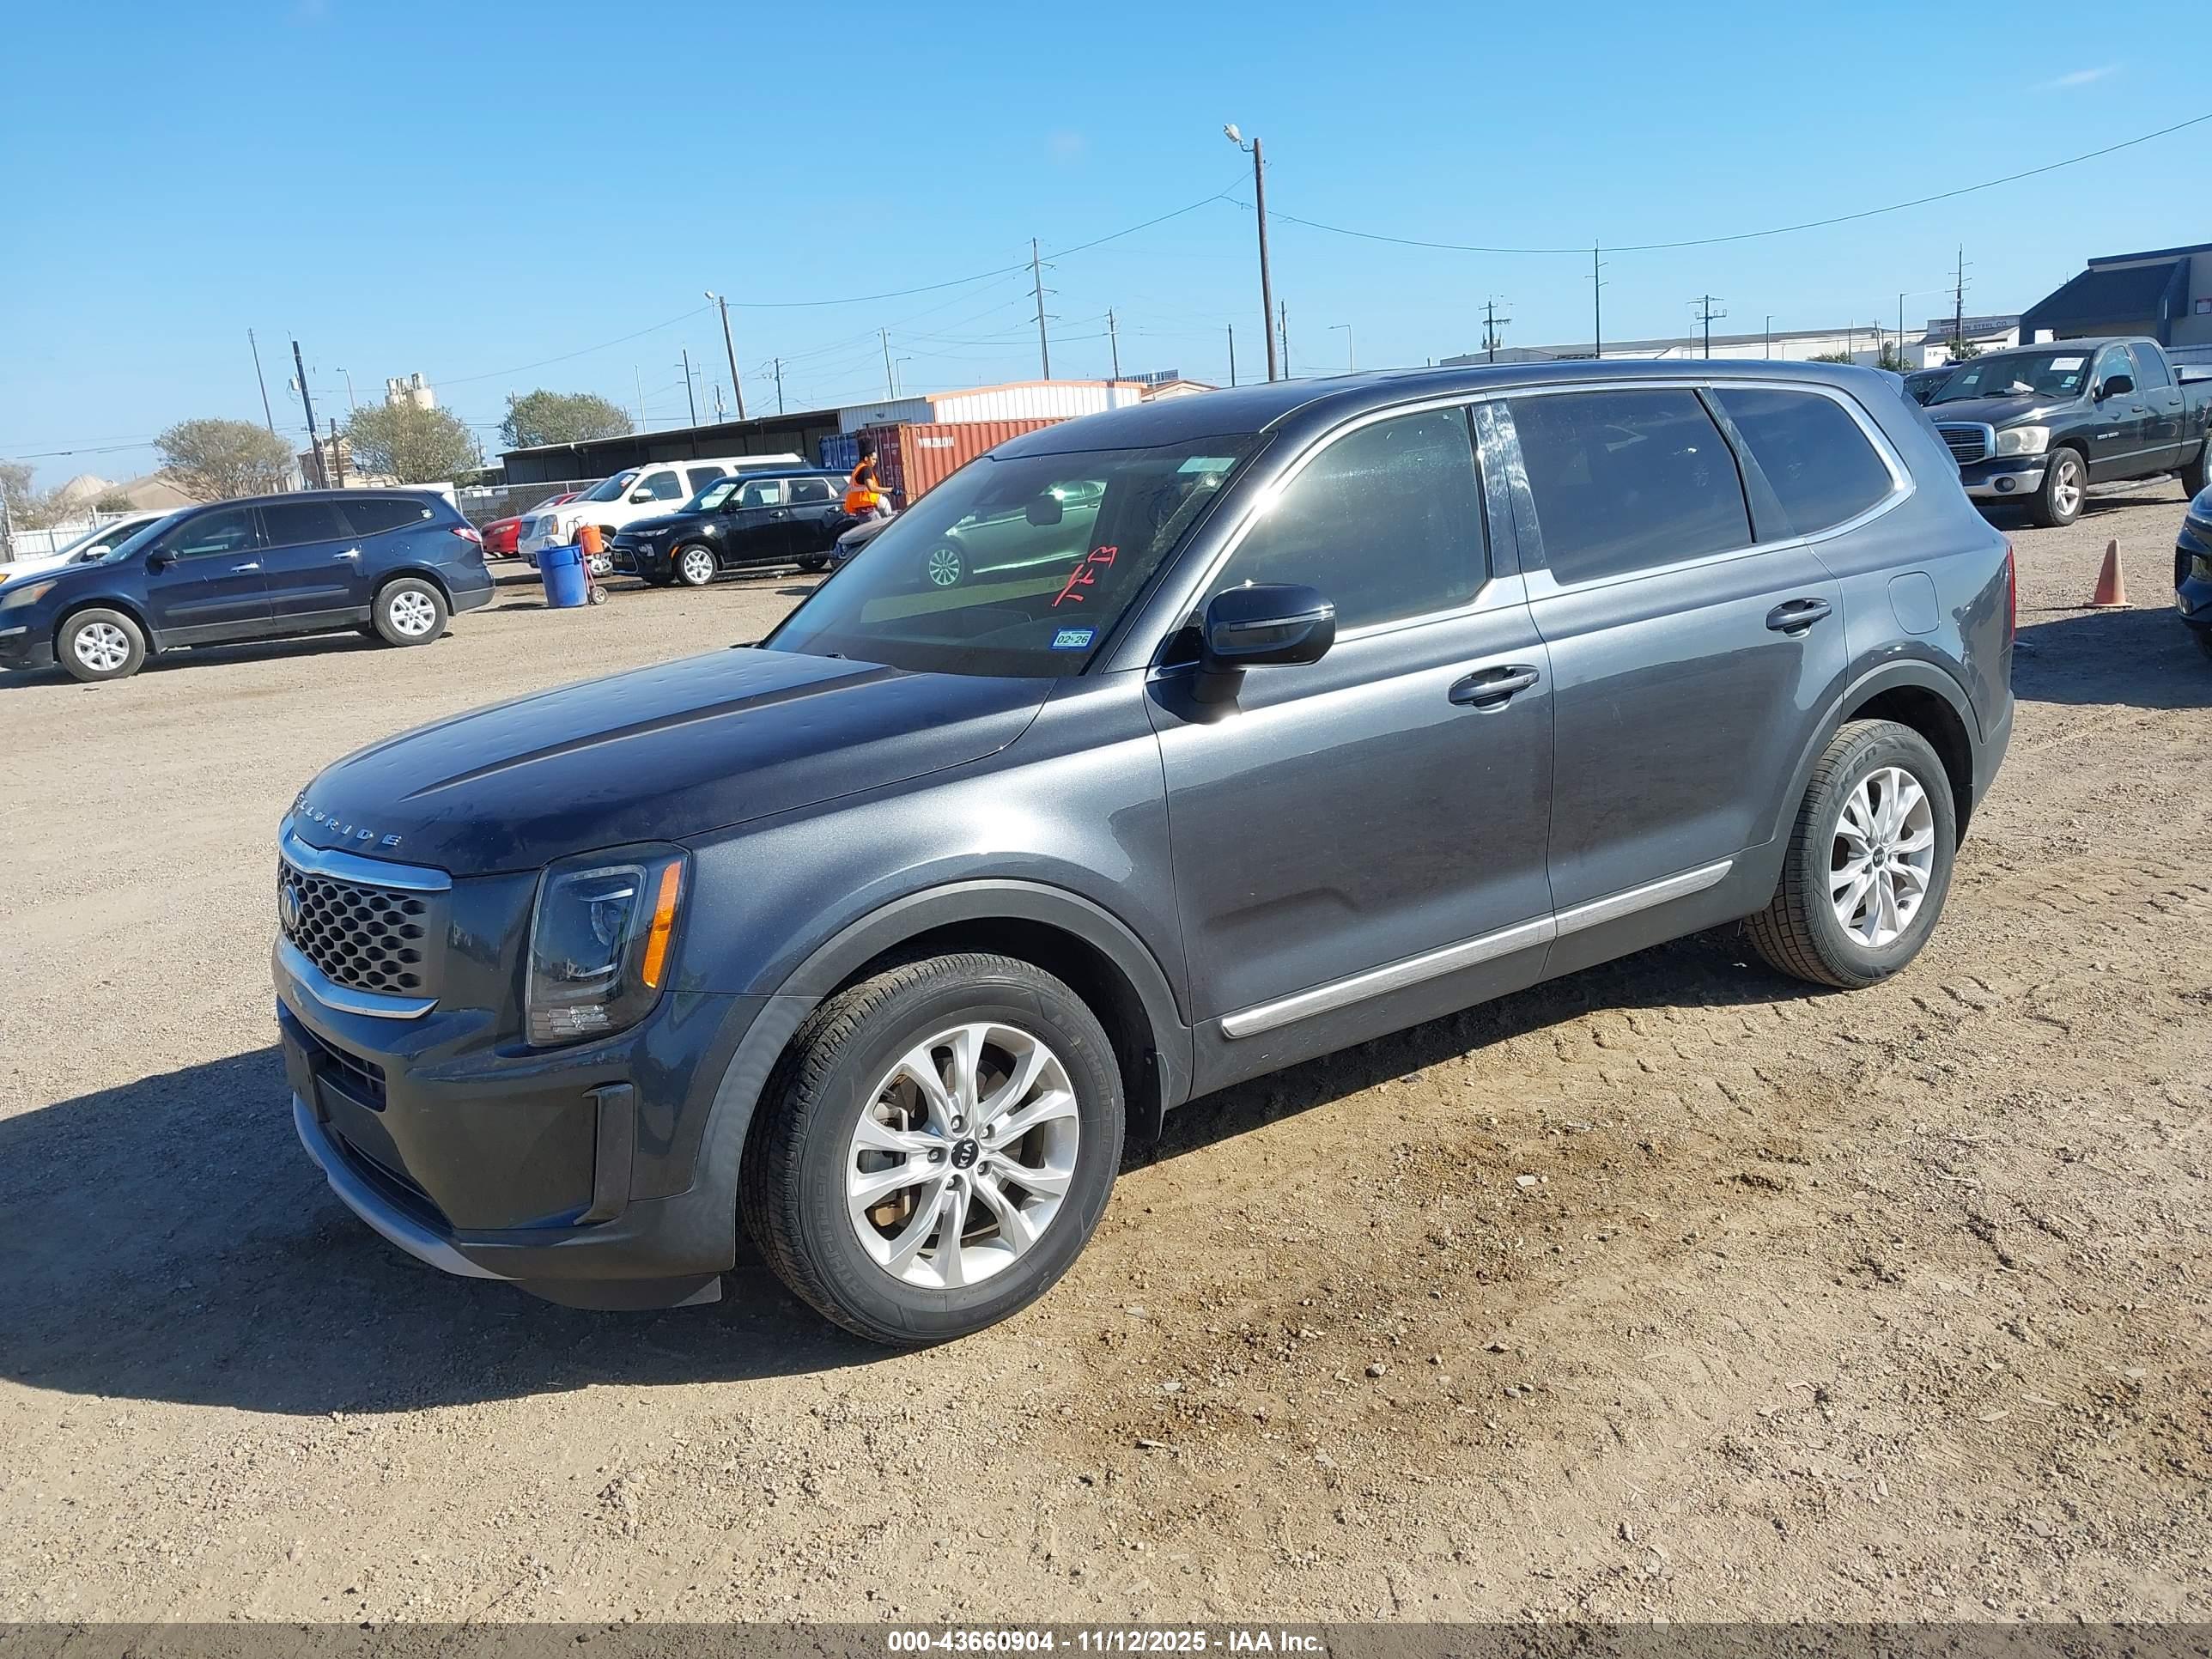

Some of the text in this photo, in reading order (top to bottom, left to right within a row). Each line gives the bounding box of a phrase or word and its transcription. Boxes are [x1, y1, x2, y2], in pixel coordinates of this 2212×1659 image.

[1938, 324, 1971, 333] WESTN
[296, 793, 402, 846] ELLURIDE
[957, 1143, 973, 1167] KIA
